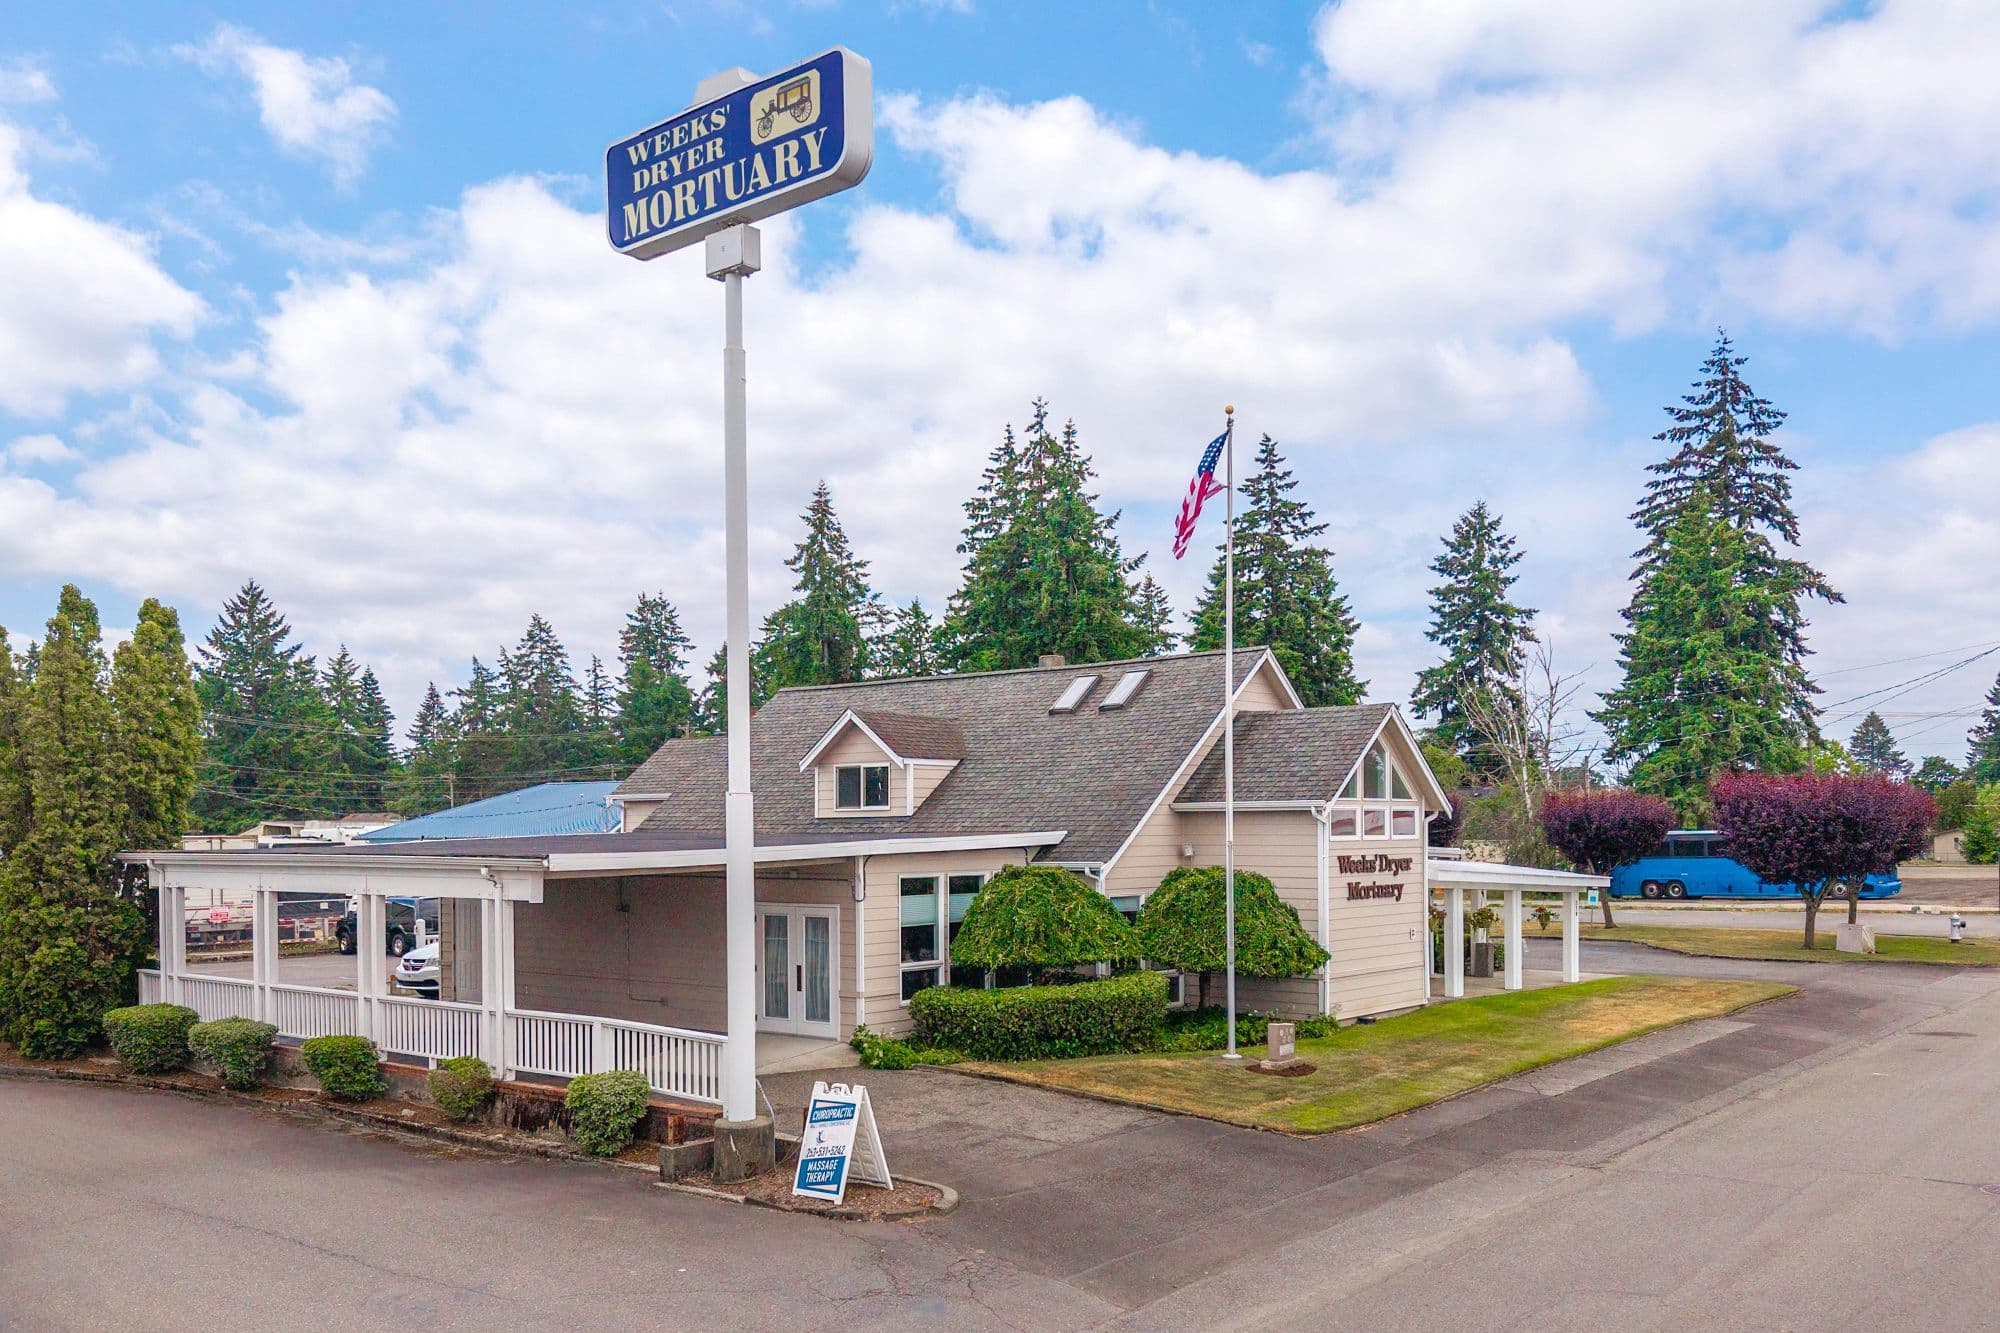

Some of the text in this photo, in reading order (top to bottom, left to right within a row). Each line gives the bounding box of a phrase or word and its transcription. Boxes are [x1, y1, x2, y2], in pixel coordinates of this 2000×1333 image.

[627, 104, 731, 166] WEEKS'
[633, 137, 726, 193] DRYER
[623, 126, 828, 241] MORTUARY
[1337, 853, 1413, 877] Weeks' Dryer
[1346, 881, 1404, 902] Mortuary
[812, 1107, 853, 1120] CHIROPRACTIC
[807, 1160, 838, 1171] MASSAGE
[806, 1171, 834, 1183] THERAPY
